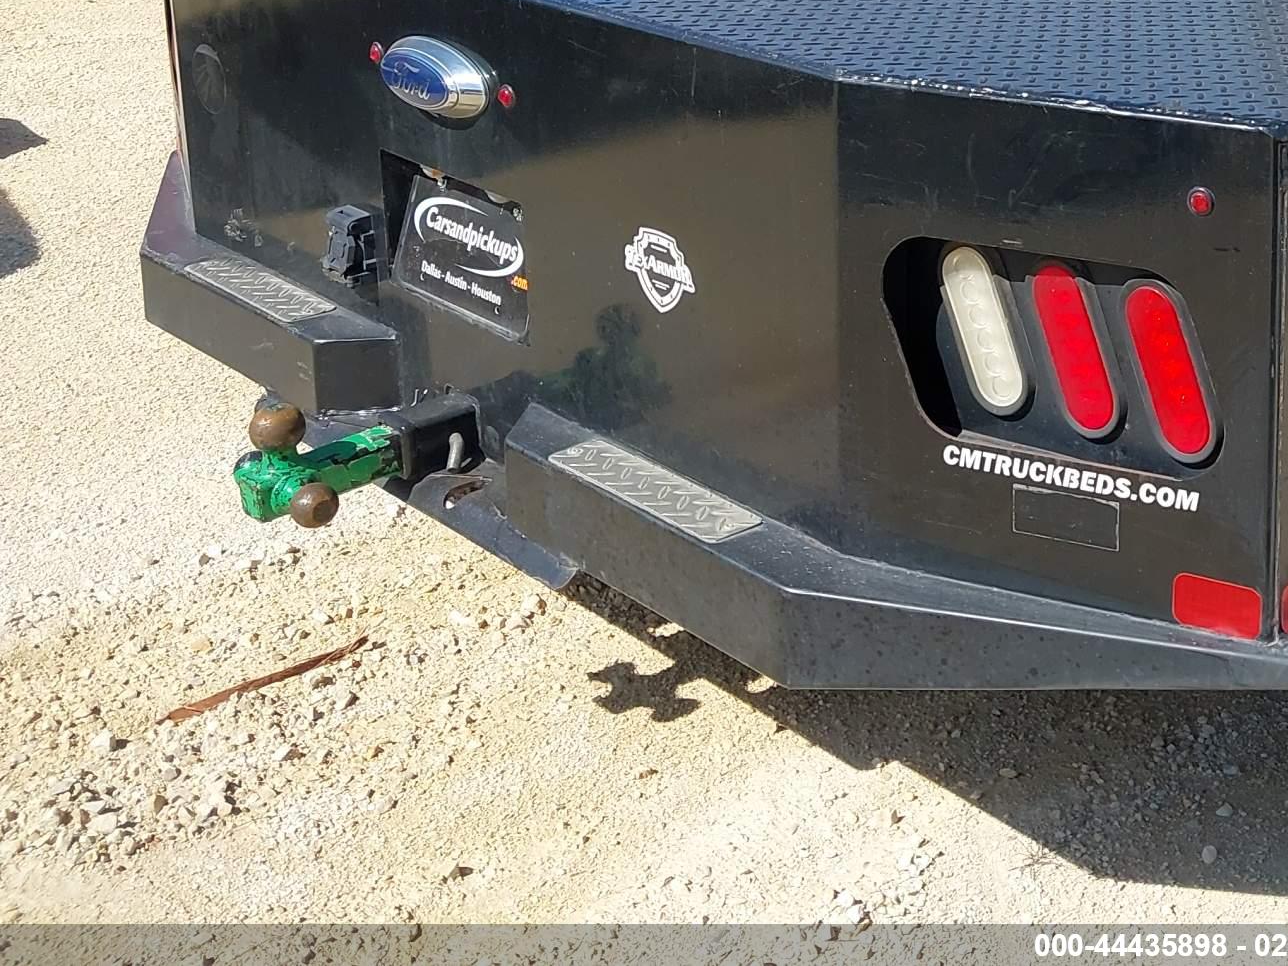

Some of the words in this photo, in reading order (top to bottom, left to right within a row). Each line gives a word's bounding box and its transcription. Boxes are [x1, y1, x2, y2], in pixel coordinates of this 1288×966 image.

[391, 60, 431, 101] Ford
[426, 206, 518, 264] Carsandpickups
[421, 260, 442, 279] Dallas
[445, 271, 467, 291] Austin
[471, 282, 501, 305] Houston
[943, 445, 1199, 512] CMTRUCKBEDS.COM
